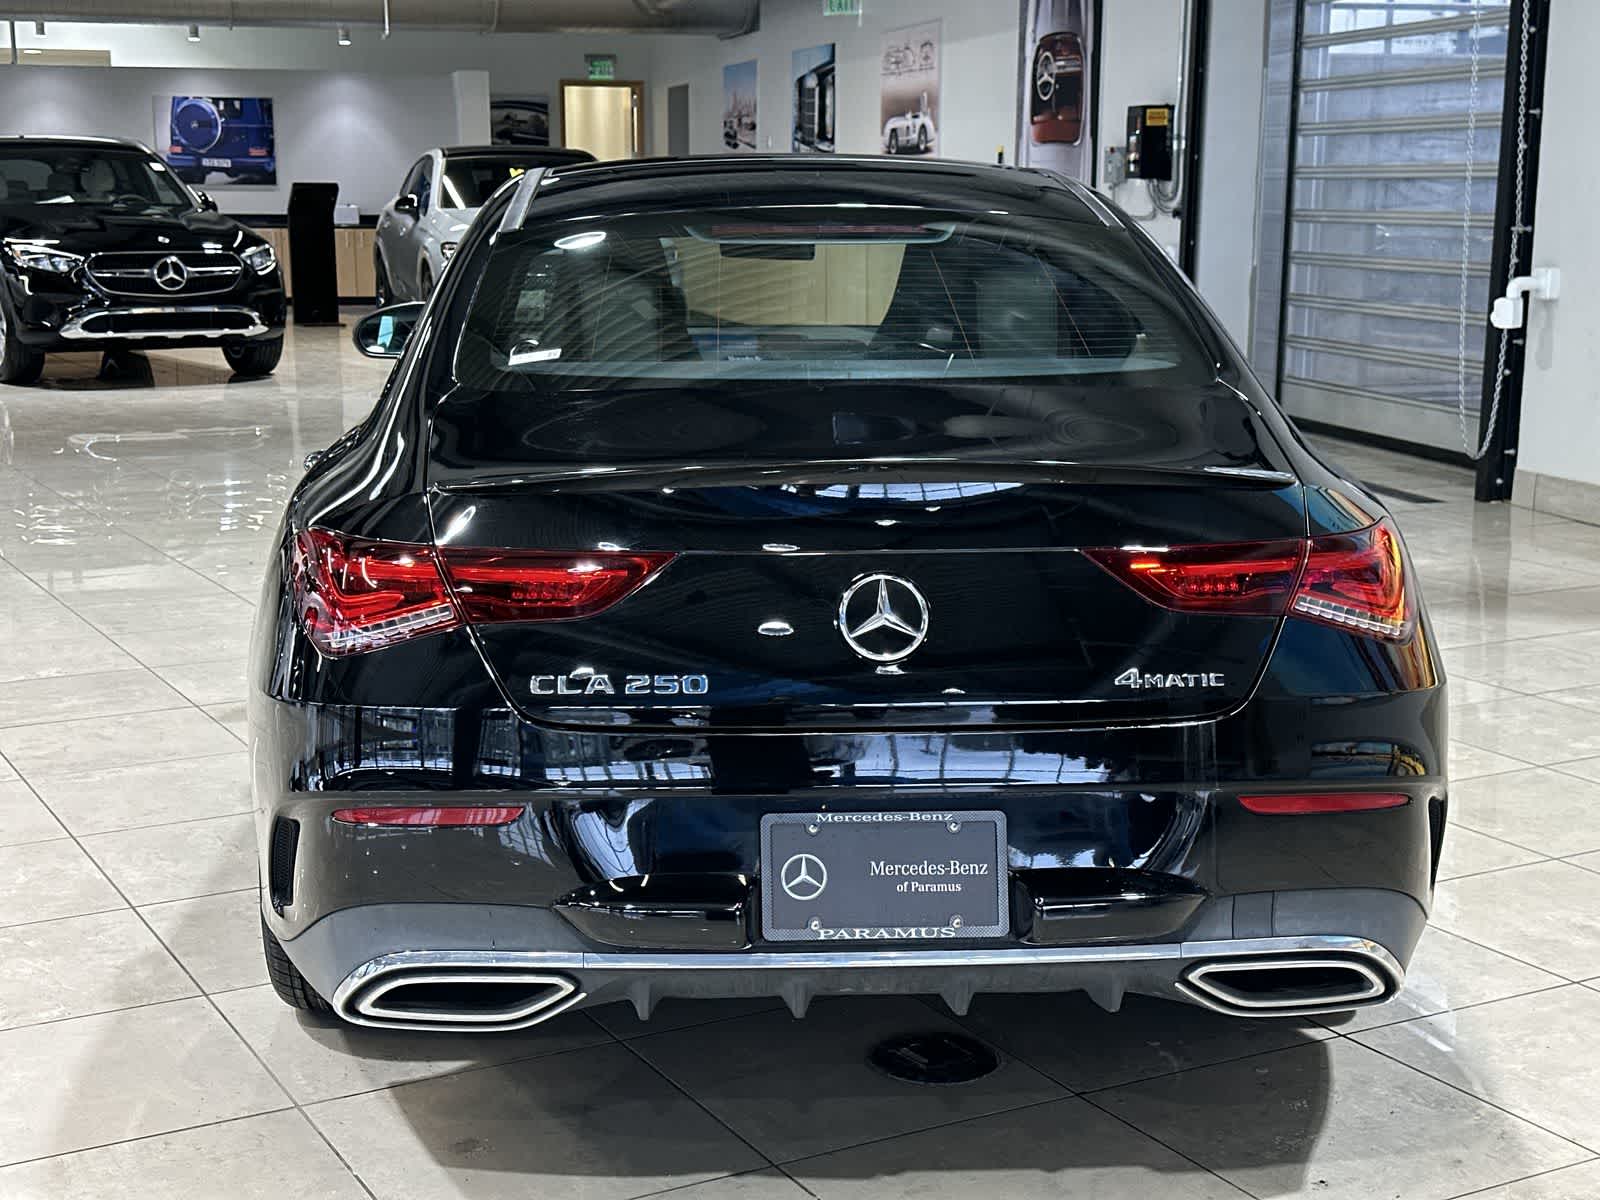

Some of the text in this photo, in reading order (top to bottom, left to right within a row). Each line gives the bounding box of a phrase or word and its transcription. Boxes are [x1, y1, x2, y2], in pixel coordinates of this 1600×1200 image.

[529, 674, 709, 695] CLA 250
[1114, 667, 1225, 689] 4MATIC
[815, 812, 954, 823] Mercedes-Benz
[869, 860, 988, 876] Mercedes-Benz
[896, 881, 962, 893] of Paramus
[817, 927, 956, 940] PARAMUS
